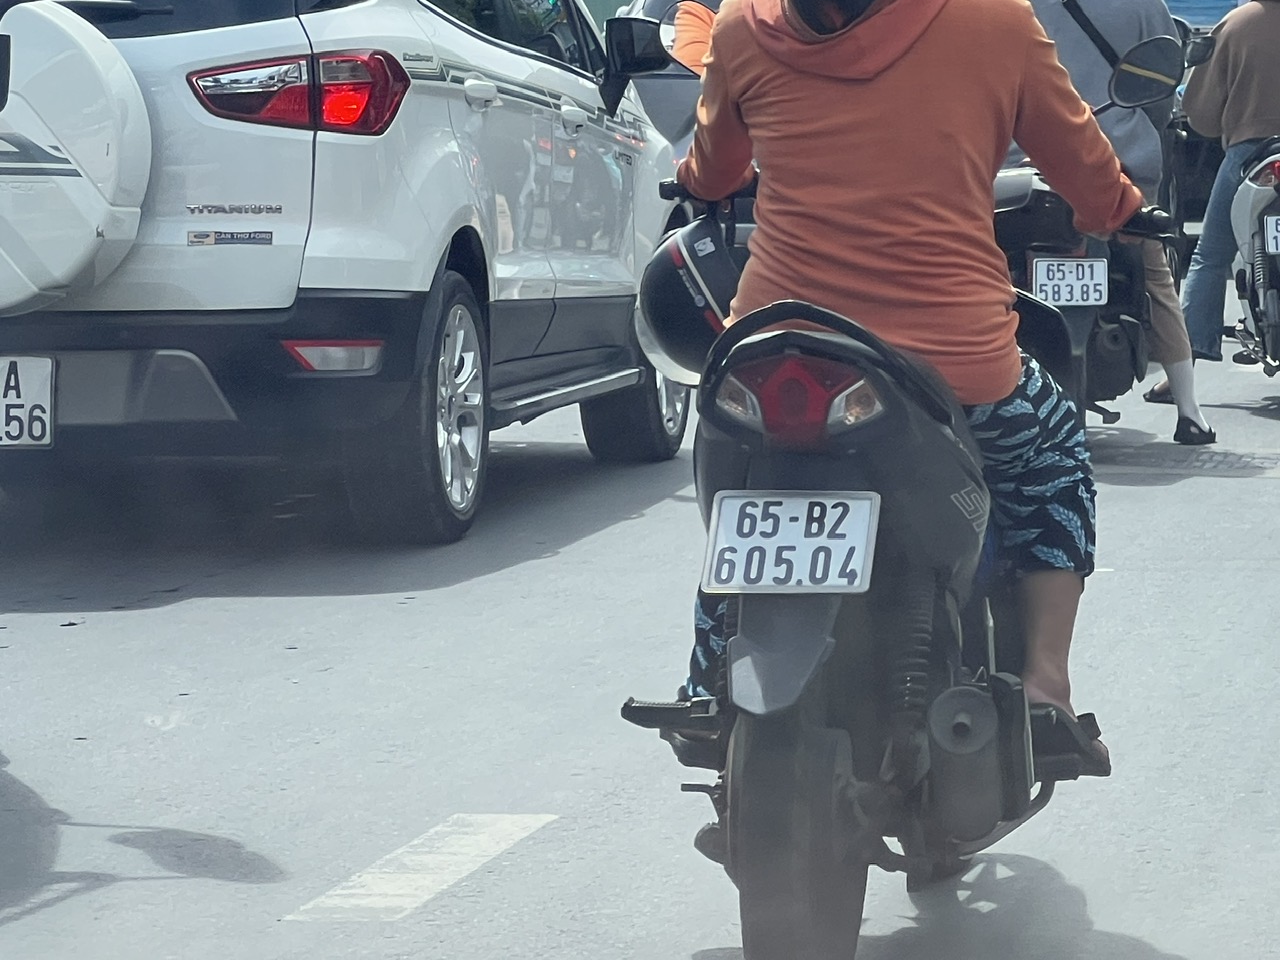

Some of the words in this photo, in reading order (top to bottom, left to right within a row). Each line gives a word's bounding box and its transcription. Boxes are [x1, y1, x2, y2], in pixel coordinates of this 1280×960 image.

[186, 204, 283, 215] TITANIUM
[250, 232, 272, 240] FORD
[1046, 263, 1094, 281] 65-D1
[1039, 283, 1103, 302] 583.85
[736, 500, 851, 540] 65-B2
[714, 545, 858, 586] 605.04
